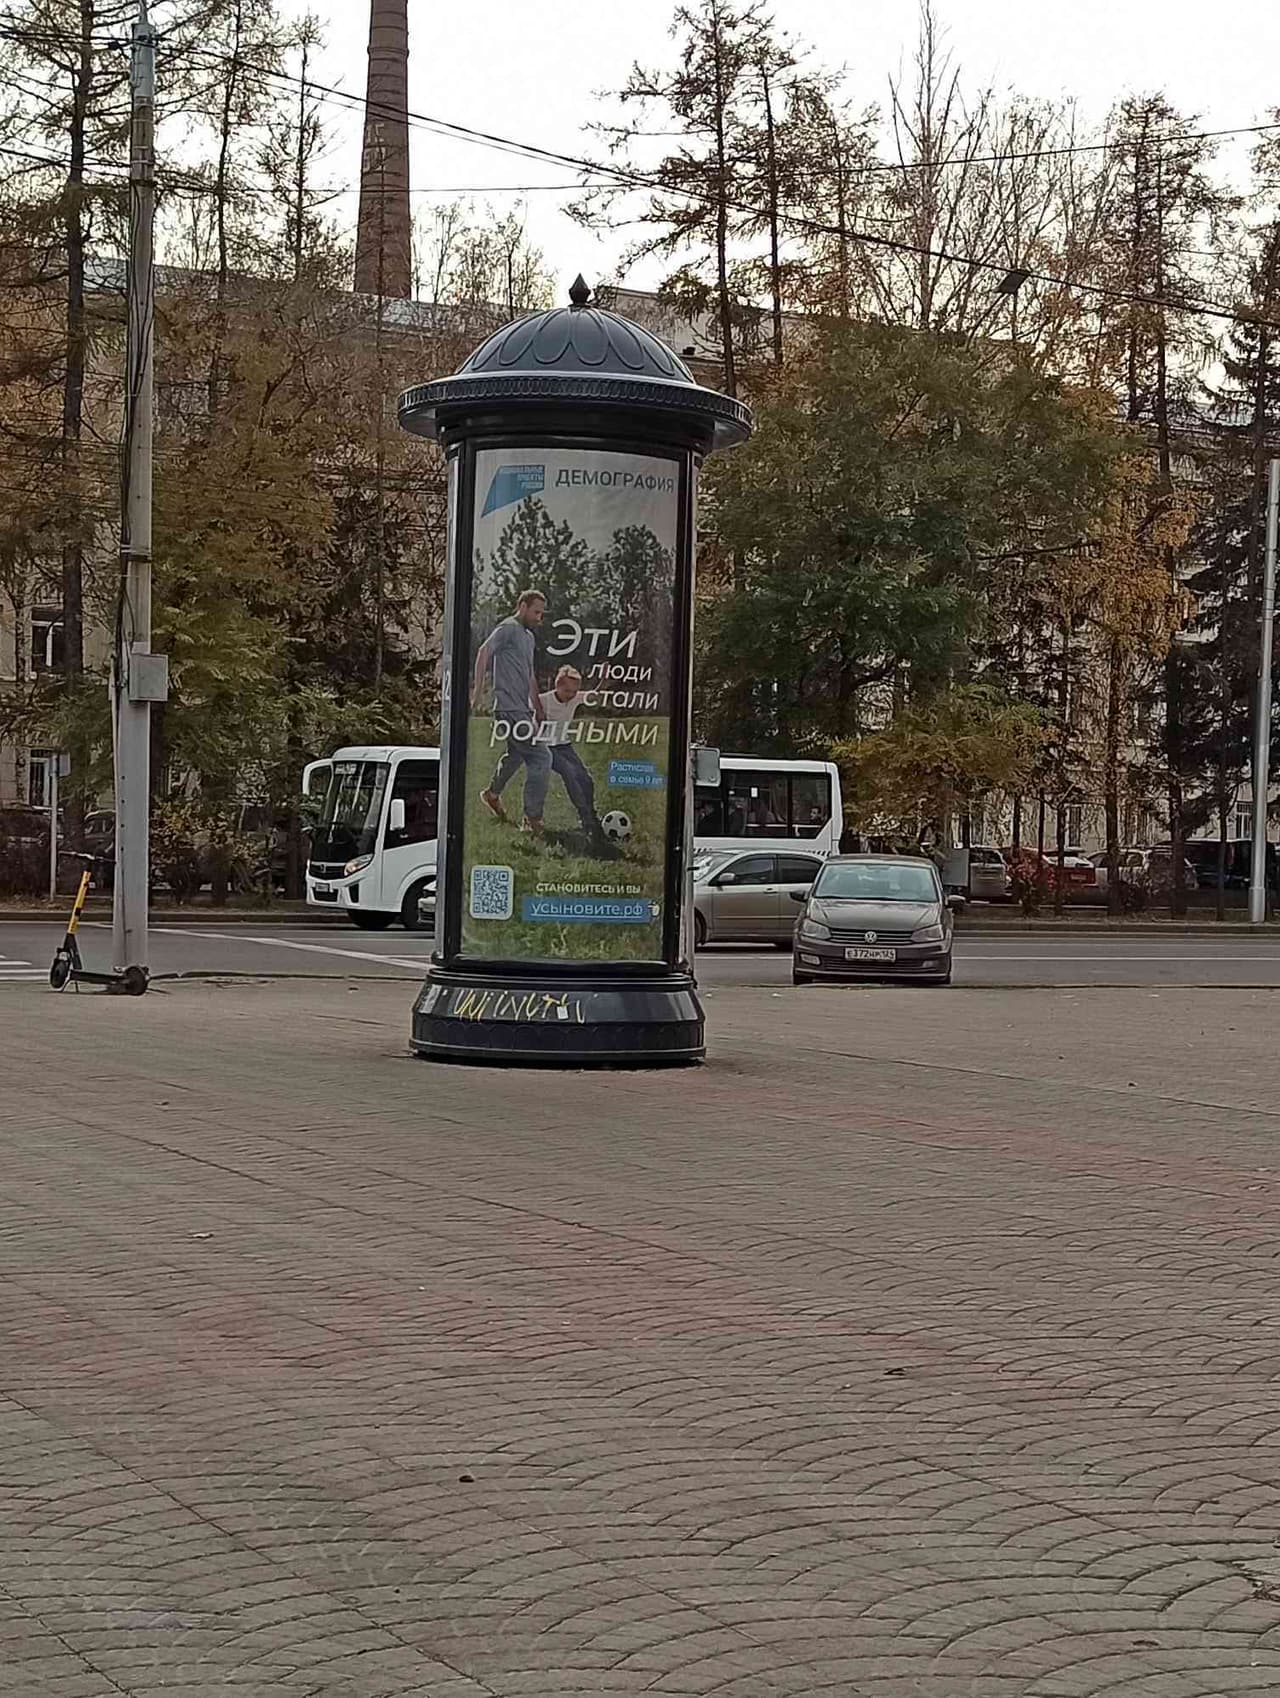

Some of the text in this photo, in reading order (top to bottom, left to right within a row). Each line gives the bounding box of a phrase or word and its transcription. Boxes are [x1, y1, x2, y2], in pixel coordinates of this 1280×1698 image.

[555, 468, 674, 492] ДЕМОГРАФИЯ
[546, 618, 638, 659] Эти
[587, 663, 652, 683] люди
[582, 688, 659, 711] стали
[489, 718, 659, 749] родными
[536, 883, 615, 893] СТАНОВИТЕСЬ
[626, 885, 641, 893] ВЫ
[532, 902, 643, 917] усыновите.рф
